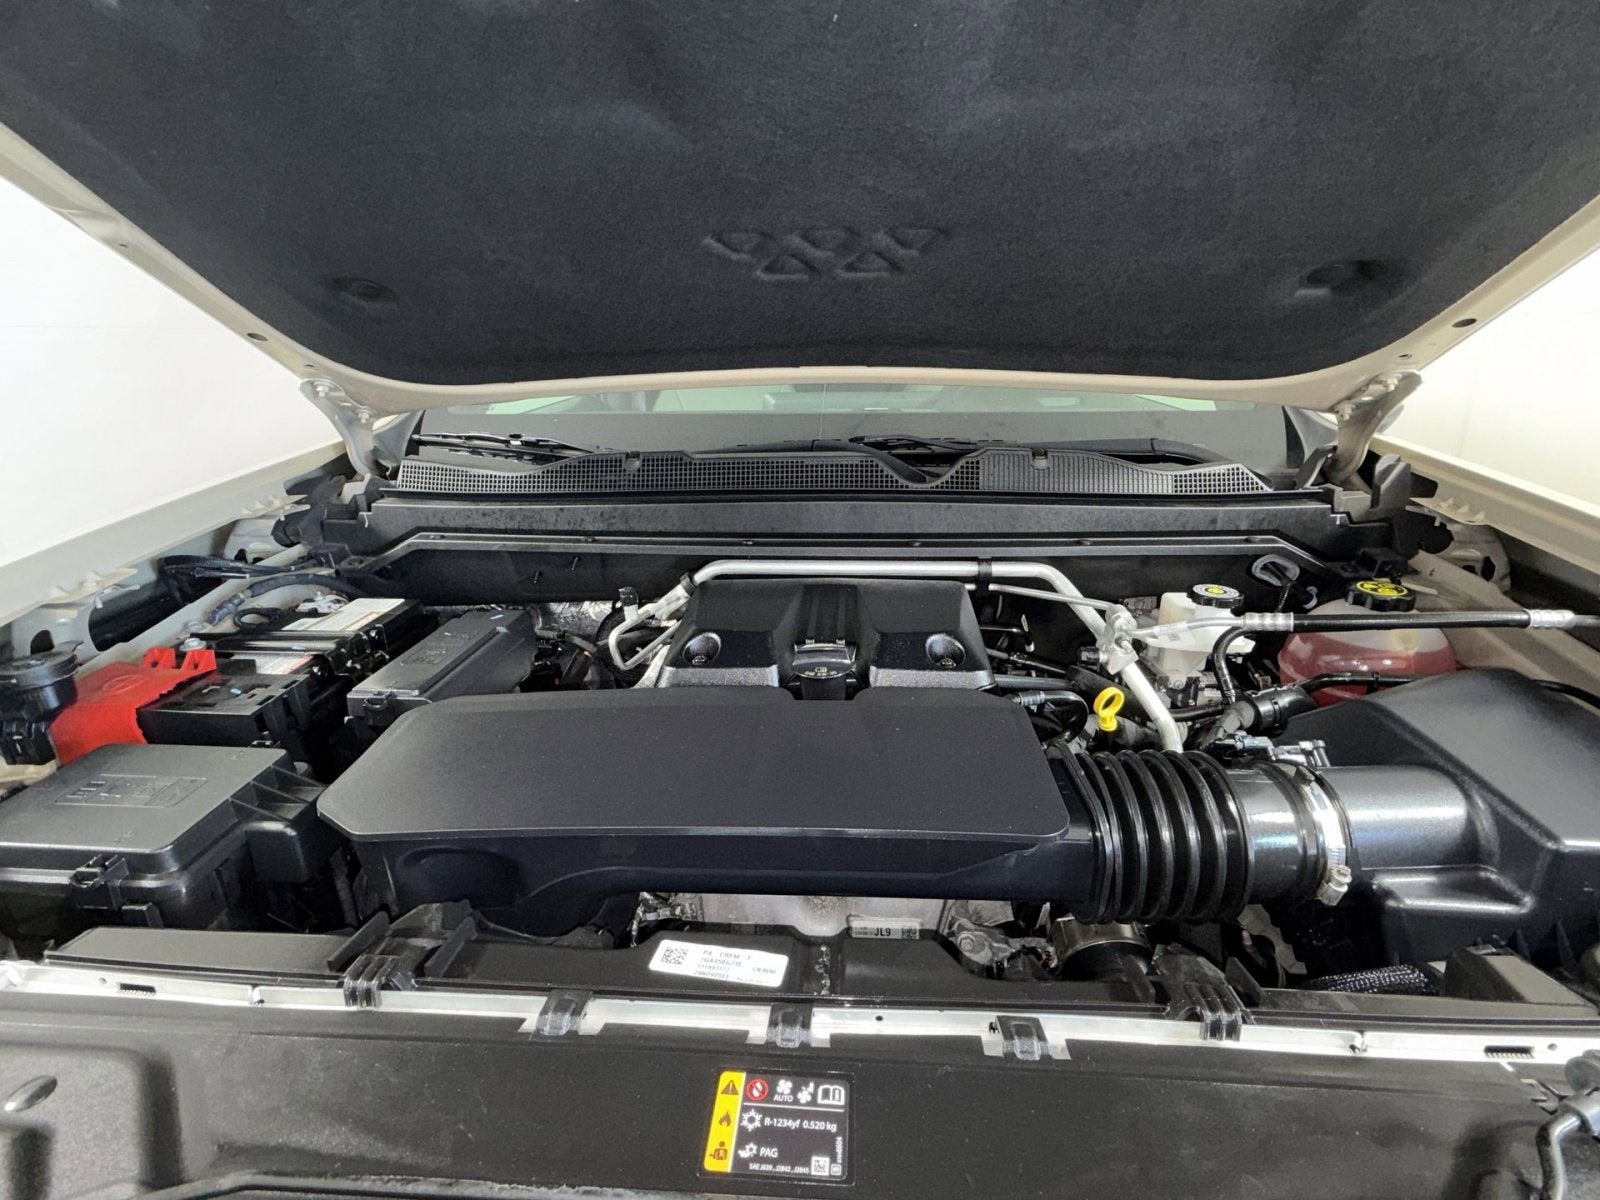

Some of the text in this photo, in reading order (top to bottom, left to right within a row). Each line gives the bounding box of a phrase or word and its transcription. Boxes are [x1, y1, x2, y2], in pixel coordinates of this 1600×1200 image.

[874, 927, 891, 937] JL9
[773, 1094, 794, 1103] AUTO
[763, 1117, 838, 1134] R-1234yf 0.520 kg
[759, 1147, 779, 1158] PAG
